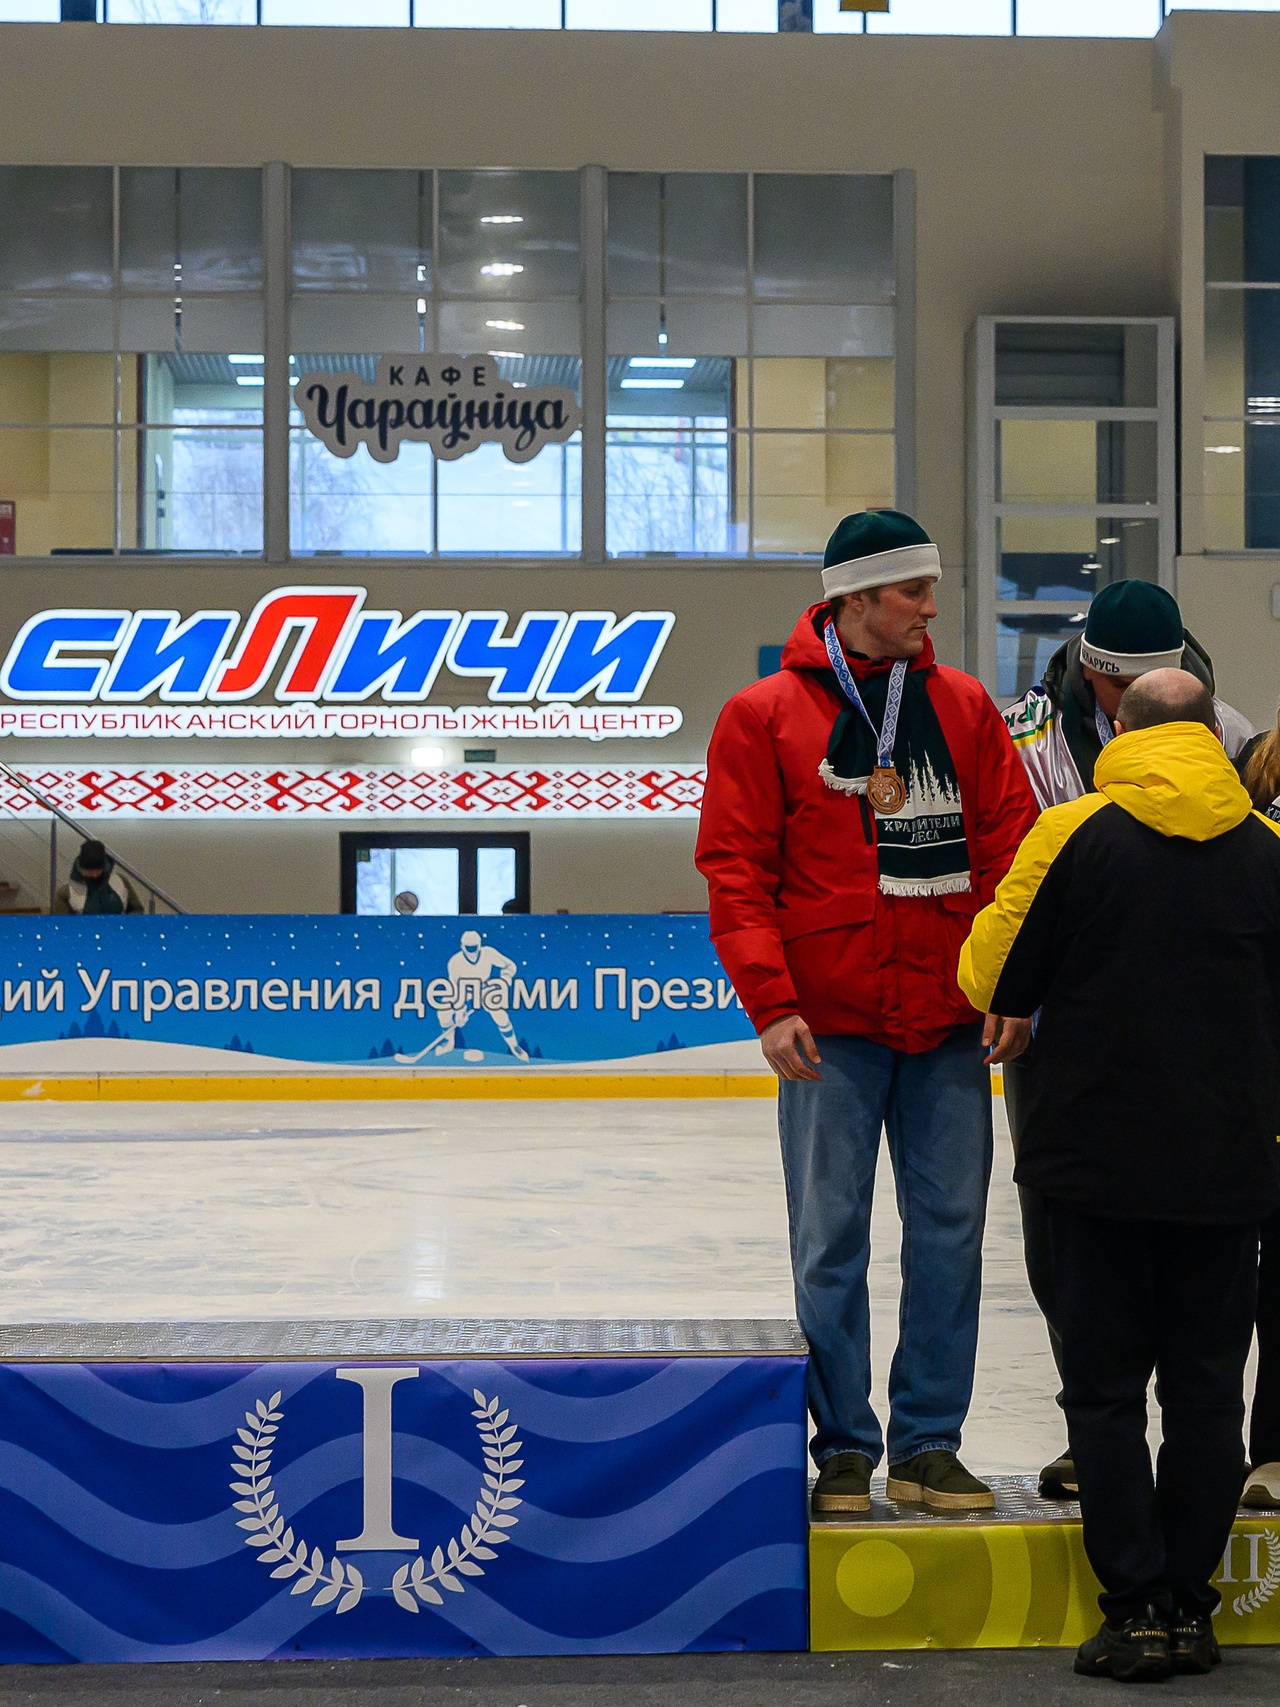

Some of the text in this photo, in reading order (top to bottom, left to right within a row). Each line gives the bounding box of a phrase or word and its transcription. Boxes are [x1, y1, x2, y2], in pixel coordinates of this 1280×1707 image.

[389, 365, 487, 387] КАФЕ
[306, 383, 570, 451] Чараўніца
[0, 707, 675, 733] РЕСПУБЛИКАНСКИЙ ГОРНОЛЫЖНЫЙ ЦЕНТР
[909, 829, 940, 844] ЛЕСА
[0, 966, 748, 1023] ий Управления делами Прези
